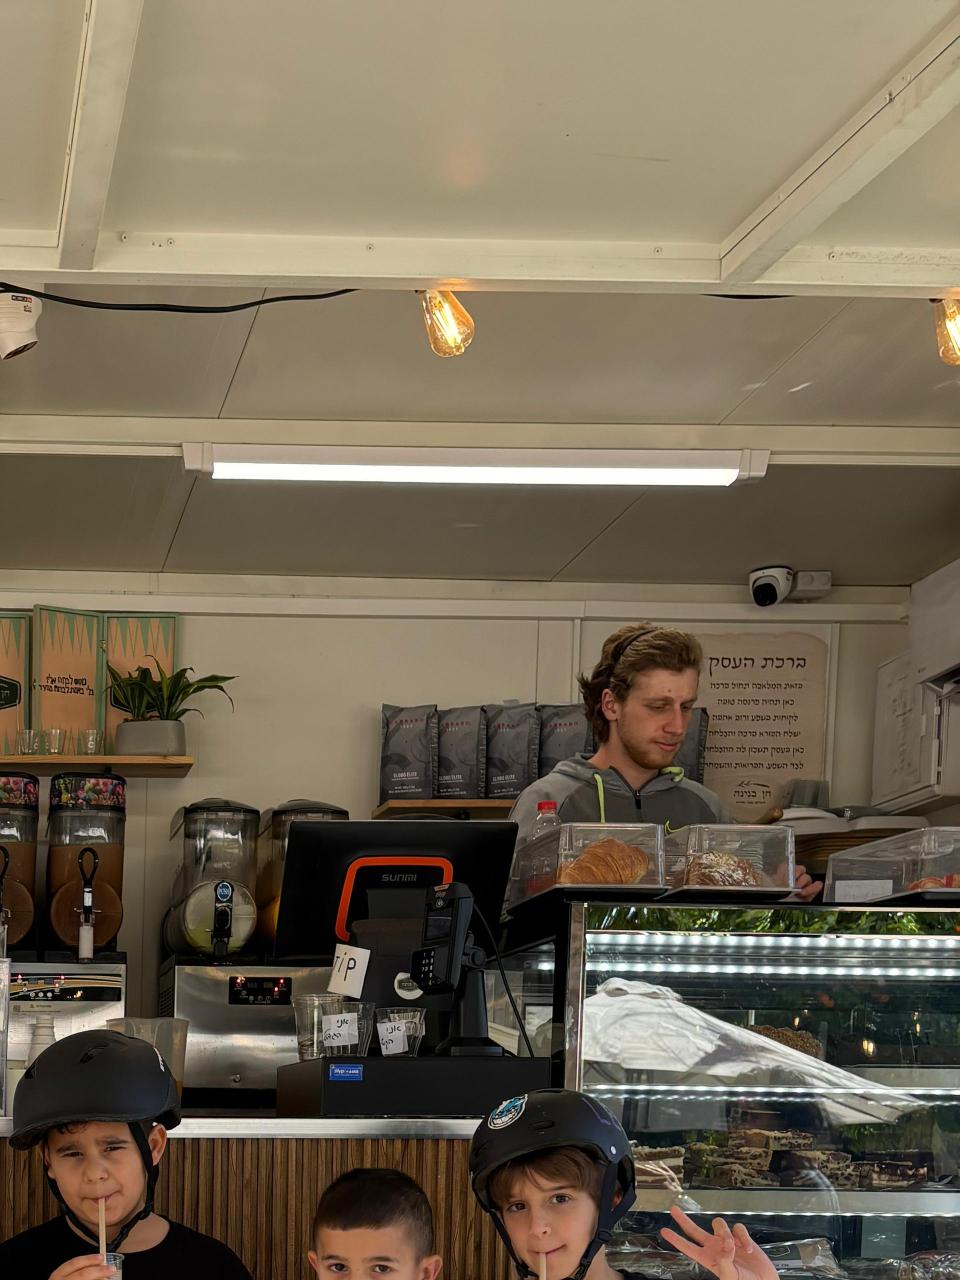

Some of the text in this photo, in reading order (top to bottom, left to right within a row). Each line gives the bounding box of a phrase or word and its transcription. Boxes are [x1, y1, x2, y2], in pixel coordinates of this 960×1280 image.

[708, 656, 807, 677] ברכת העסק
[733, 789, 772, 800] חן בגינה
